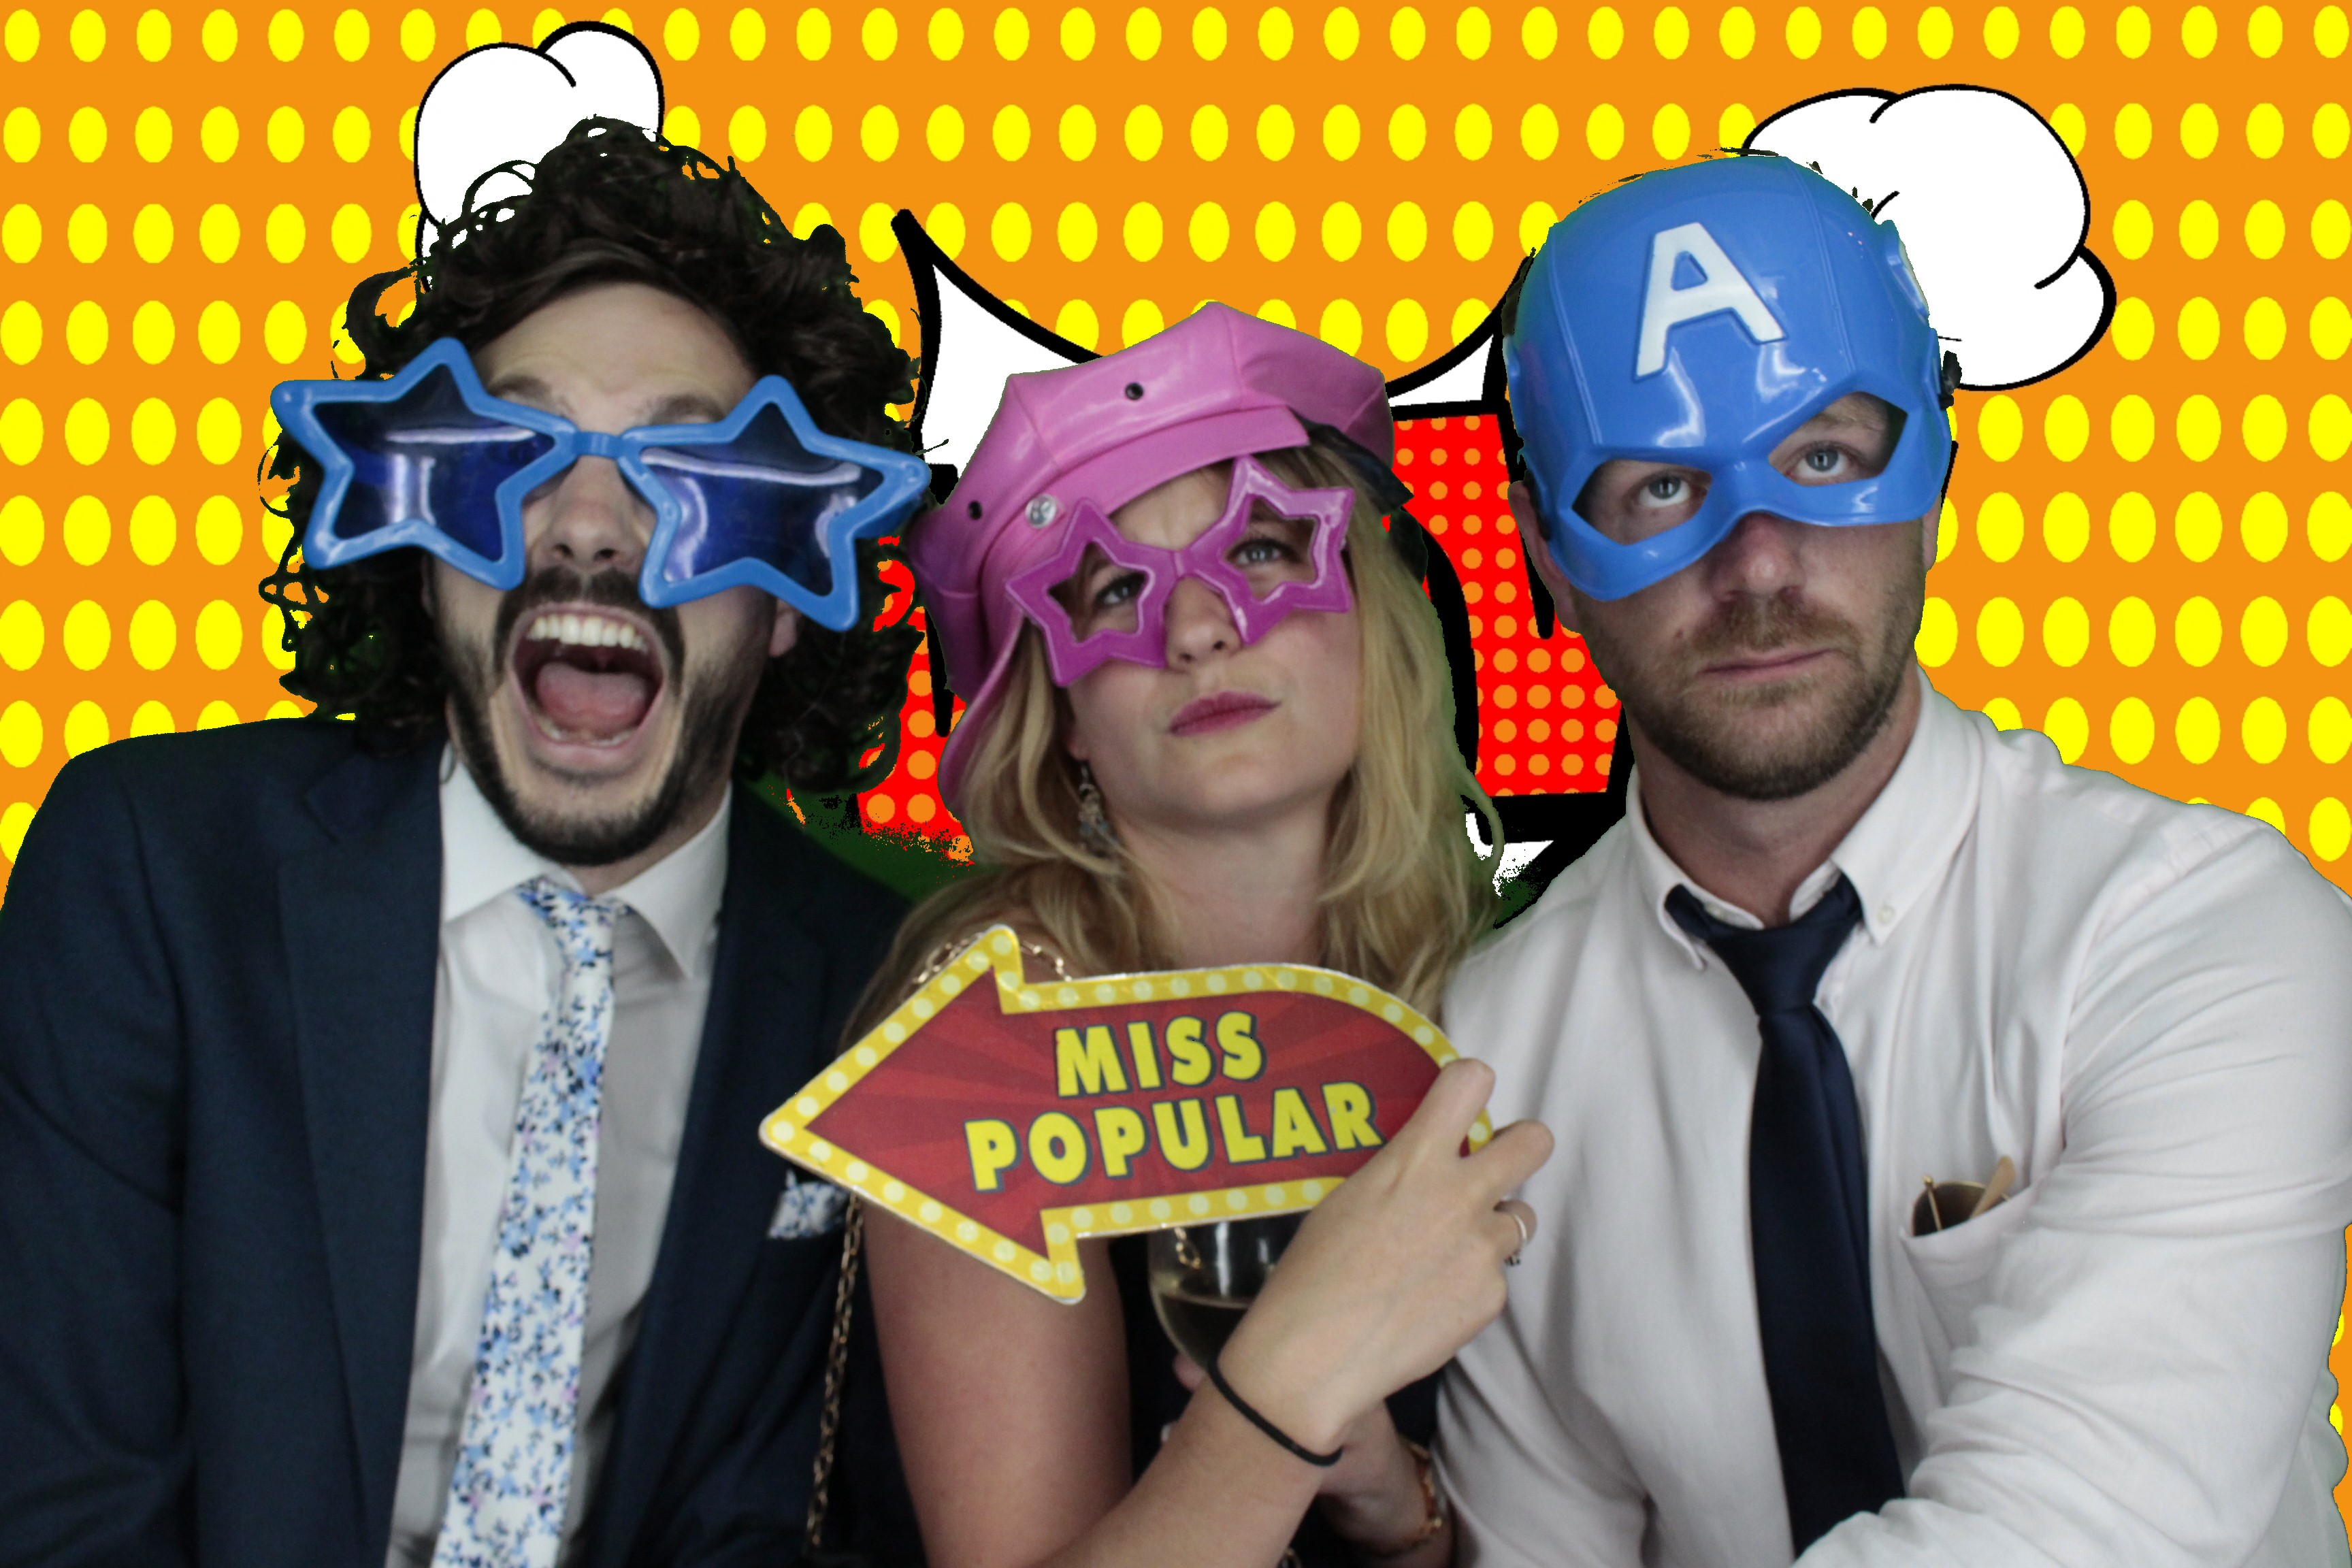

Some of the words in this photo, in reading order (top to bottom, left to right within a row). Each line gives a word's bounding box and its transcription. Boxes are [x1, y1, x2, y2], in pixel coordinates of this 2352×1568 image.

[1635, 222, 1786, 378] A
[1055, 1011, 1262, 1097] MISS
[964, 1081, 1382, 1191] POPULAR
